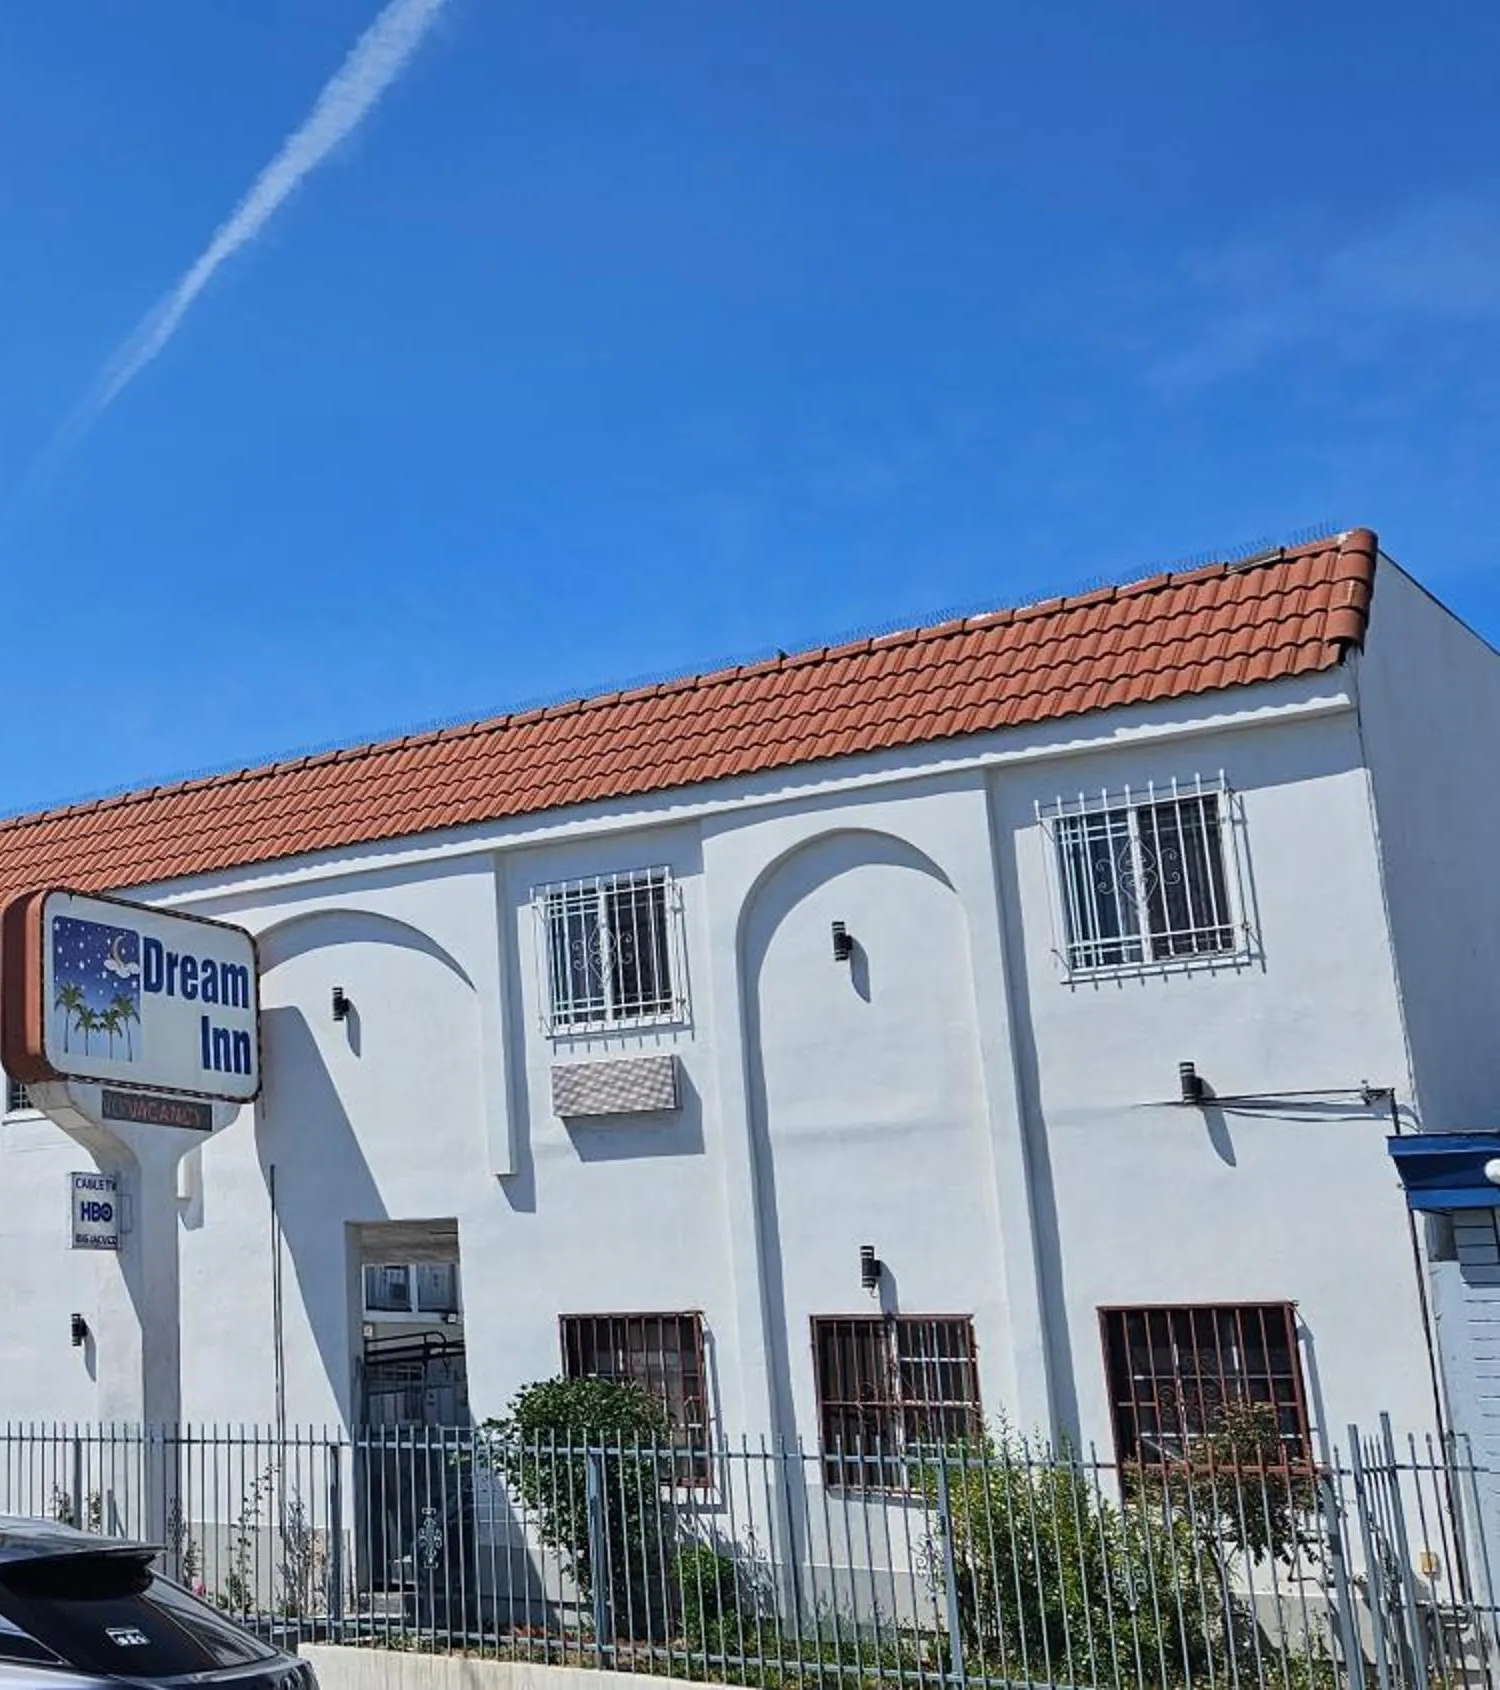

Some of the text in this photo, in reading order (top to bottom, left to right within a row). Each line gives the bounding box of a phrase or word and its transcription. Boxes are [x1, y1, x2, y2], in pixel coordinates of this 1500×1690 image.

[143, 936, 249, 1009] Dream
[201, 1015, 252, 1075] Inn
[75, 1177, 105, 1191] CABLE
[81, 1201, 113, 1222] HBO
